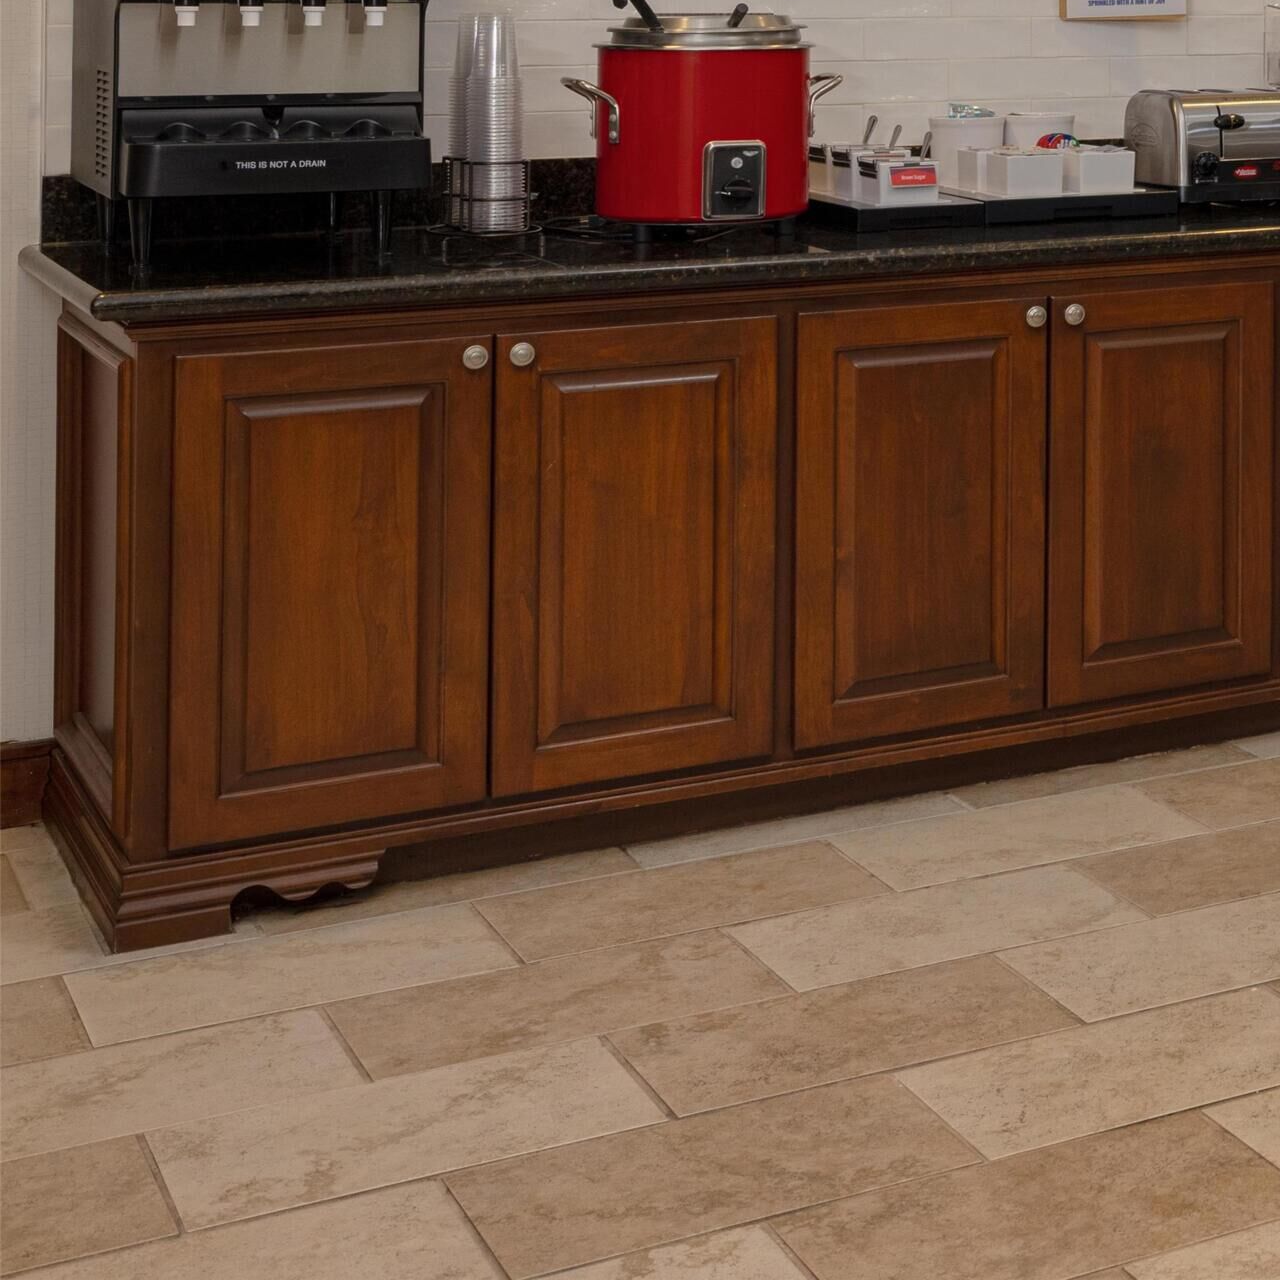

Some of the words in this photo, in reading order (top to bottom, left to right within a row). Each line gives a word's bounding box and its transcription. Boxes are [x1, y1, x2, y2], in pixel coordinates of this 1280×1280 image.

[235, 161, 257, 169] THIS
[258, 161, 268, 169] IS
[269, 160, 288, 169] NOT
[290, 160, 297, 168] A
[299, 159, 327, 168] DRAIN
